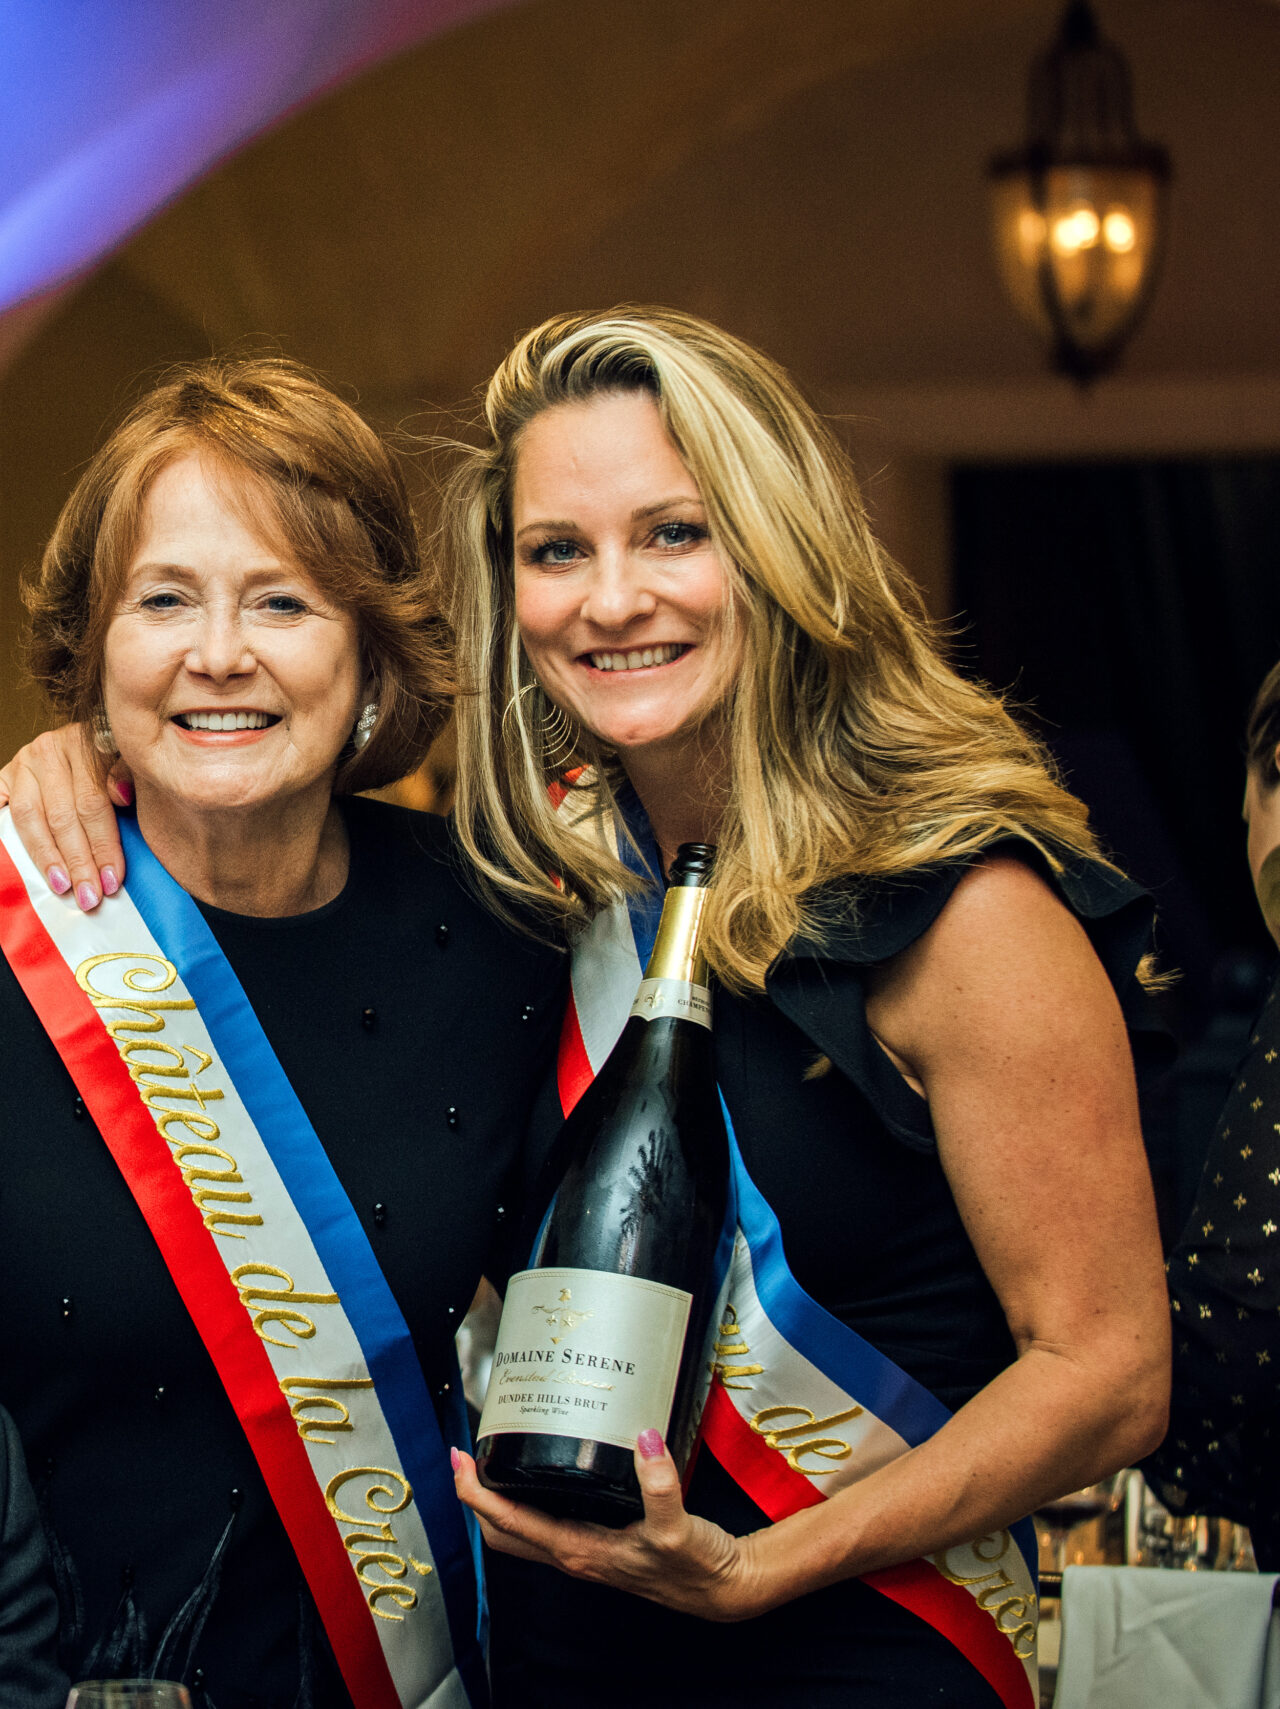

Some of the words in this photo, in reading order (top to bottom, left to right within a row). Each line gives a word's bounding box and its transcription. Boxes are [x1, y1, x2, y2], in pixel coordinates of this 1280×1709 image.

[75, 952, 264, 1239] Château
[230, 1262, 340, 1350] de
[495, 1350, 555, 1367] DOMAINE
[561, 1348, 636, 1375] SERENE
[279, 1377, 374, 1444] la
[498, 1393, 534, 1405] DUNDEE
[536, 1393, 571, 1404] HILLS
[574, 1397, 608, 1412] BRUT
[749, 1405, 864, 1476] de
[323, 1466, 434, 1622] Crée
